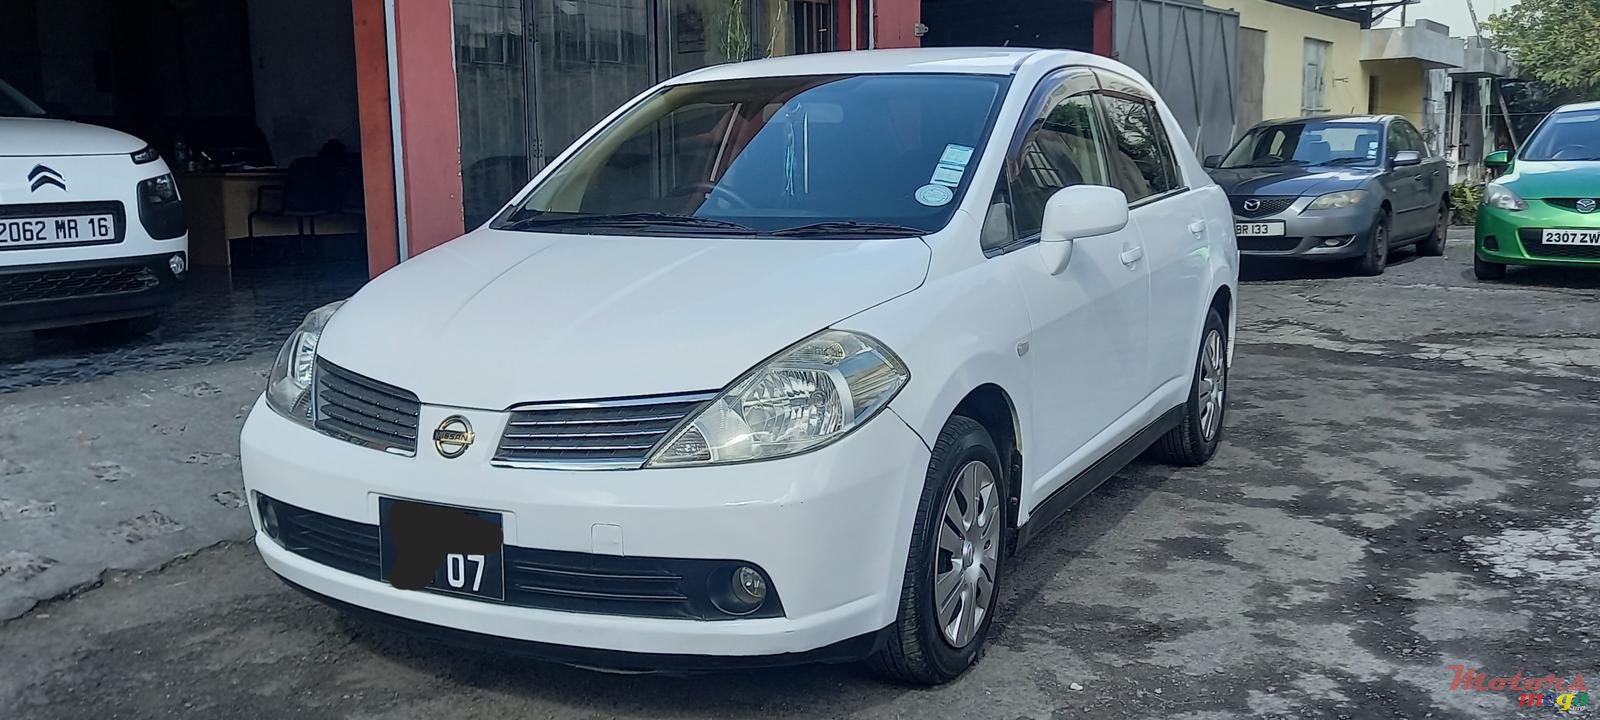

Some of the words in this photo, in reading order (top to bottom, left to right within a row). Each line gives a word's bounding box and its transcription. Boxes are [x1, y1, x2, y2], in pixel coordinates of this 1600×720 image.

[0, 221, 47, 242] 2062
[55, 220, 79, 239] MR
[88, 218, 109, 237] 16
[1251, 225, 1269, 234] 133
[1545, 233, 1577, 243] 2307
[1580, 233, 1600, 243] ZW
[437, 431, 469, 442] NISSAN
[447, 553, 485, 592] 07
